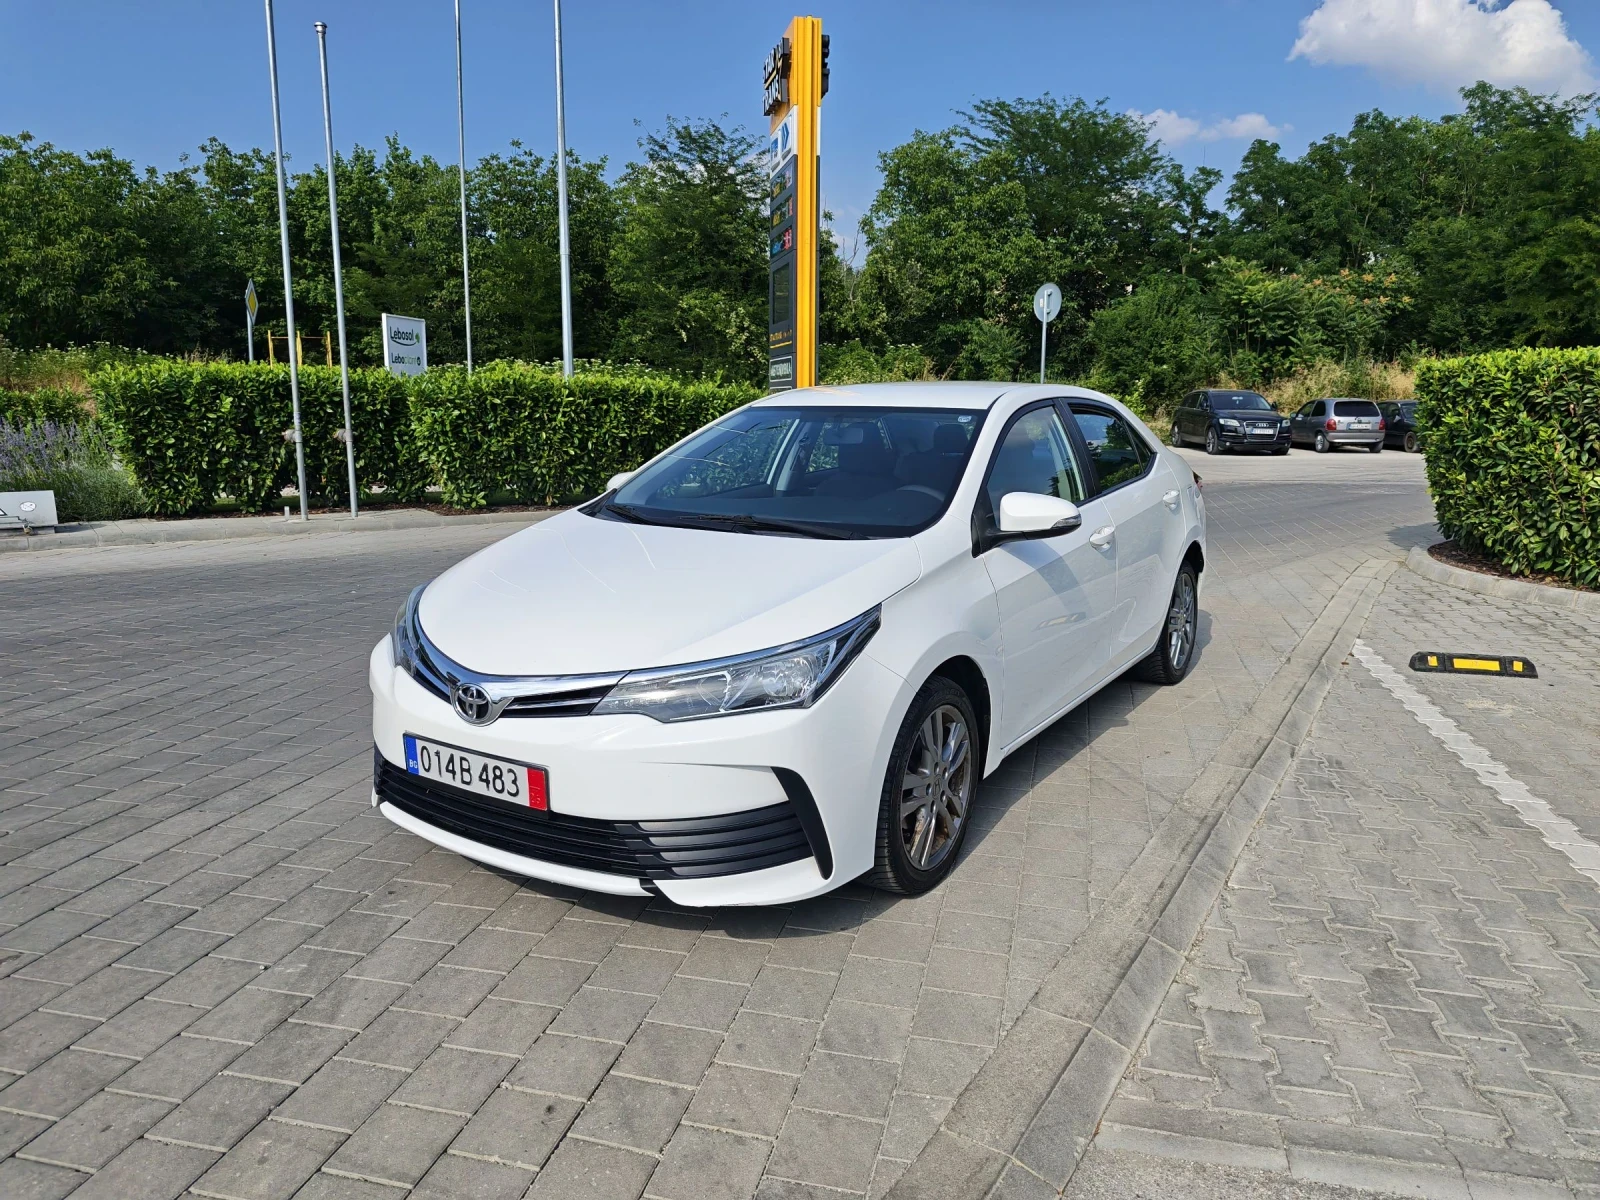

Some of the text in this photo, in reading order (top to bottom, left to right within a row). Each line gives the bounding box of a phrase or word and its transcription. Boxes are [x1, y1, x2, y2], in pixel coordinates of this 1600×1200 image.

[390, 325, 415, 341] Lebosol
[409, 745, 520, 798] BG 014B 483
